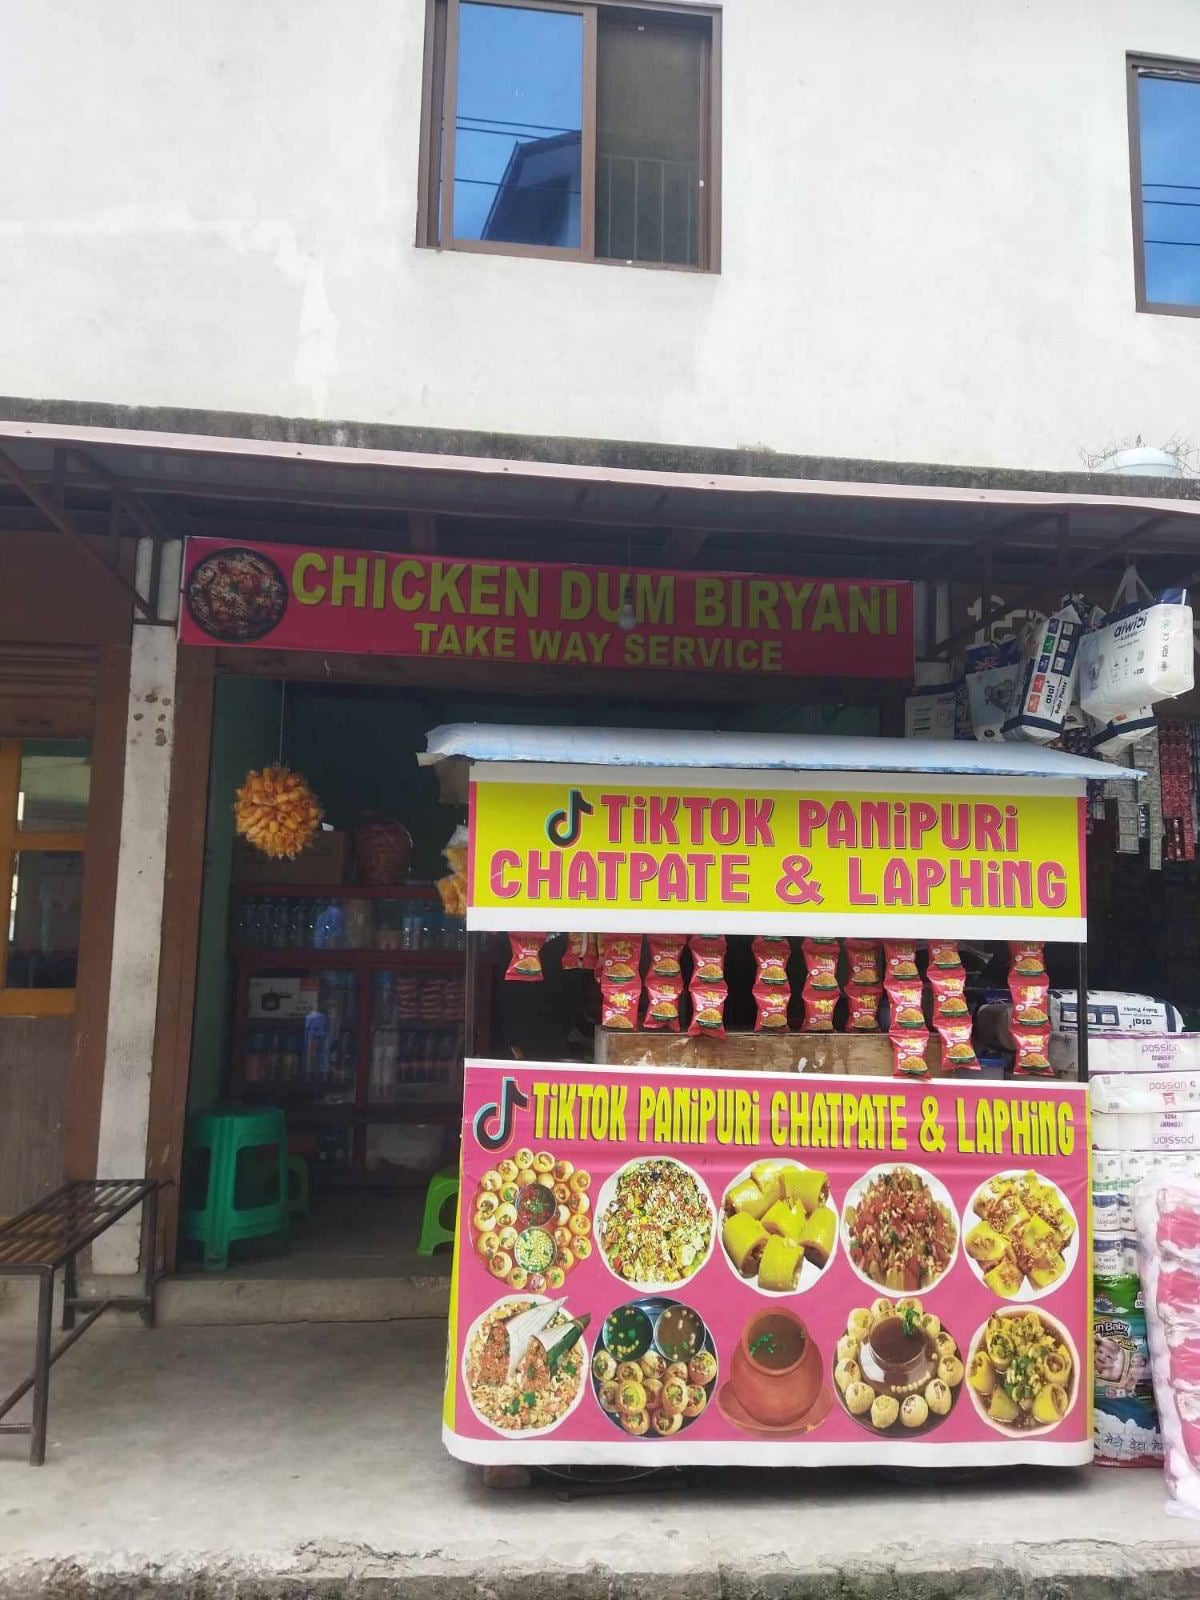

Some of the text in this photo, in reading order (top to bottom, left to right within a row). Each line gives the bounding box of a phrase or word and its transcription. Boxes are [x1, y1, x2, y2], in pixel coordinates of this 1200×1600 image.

[291, 551, 540, 619] CHICKEN
[559, 569, 675, 626] DUM
[693, 576, 898, 636] BIRYANI
[413, 622, 783, 672] TAKE WAY SERVICE
[490, 848, 749, 903] CHATPATE
[774, 853, 824, 904] &
[770, 1089, 908, 1151] CHATPATE
[920, 1095, 946, 1153] &
[1105, 1321, 1129, 1332] Baby
